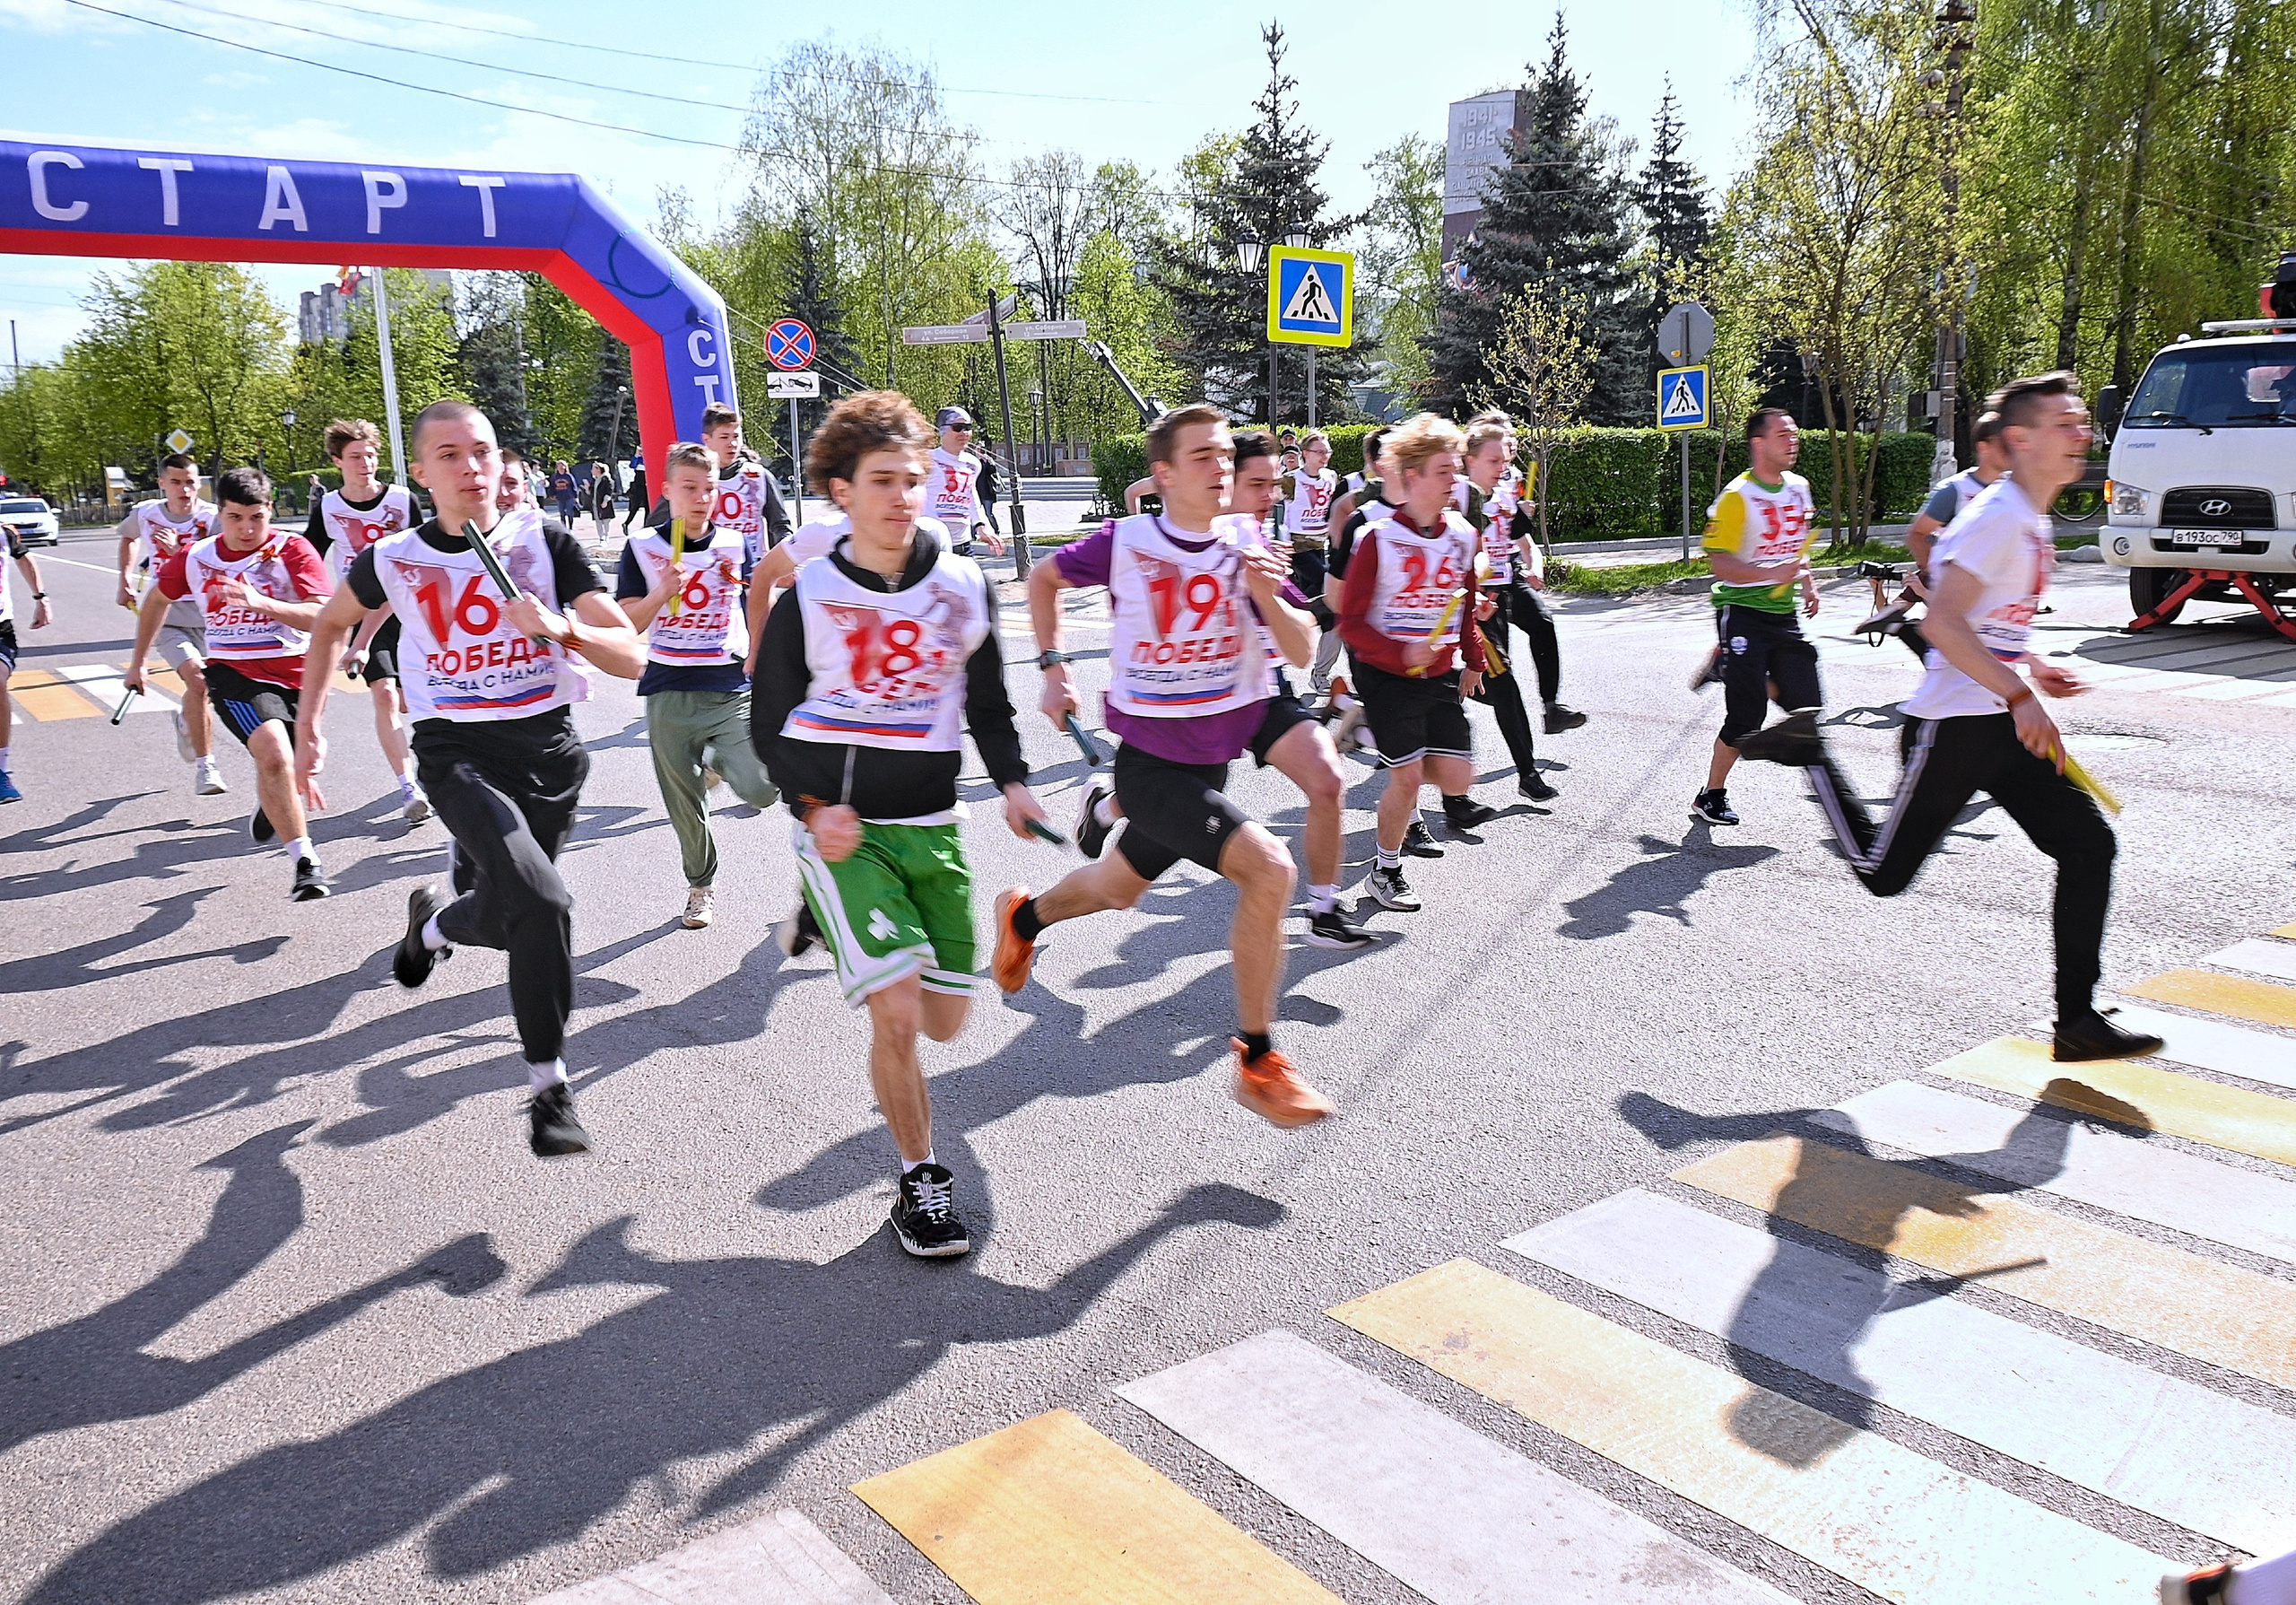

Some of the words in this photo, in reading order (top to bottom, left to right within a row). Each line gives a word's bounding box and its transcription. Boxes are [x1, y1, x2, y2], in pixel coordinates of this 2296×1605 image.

[1462, 127, 1497, 151] 1945
[26, 150, 506, 238] СТАРТ
[944, 470, 970, 493] 37
[1401, 556, 1453, 592] 26
[415, 574, 500, 643] 16
[1149, 574, 1219, 633] 19
[845, 620, 919, 682] 18
[484, 675, 496, 688] С
